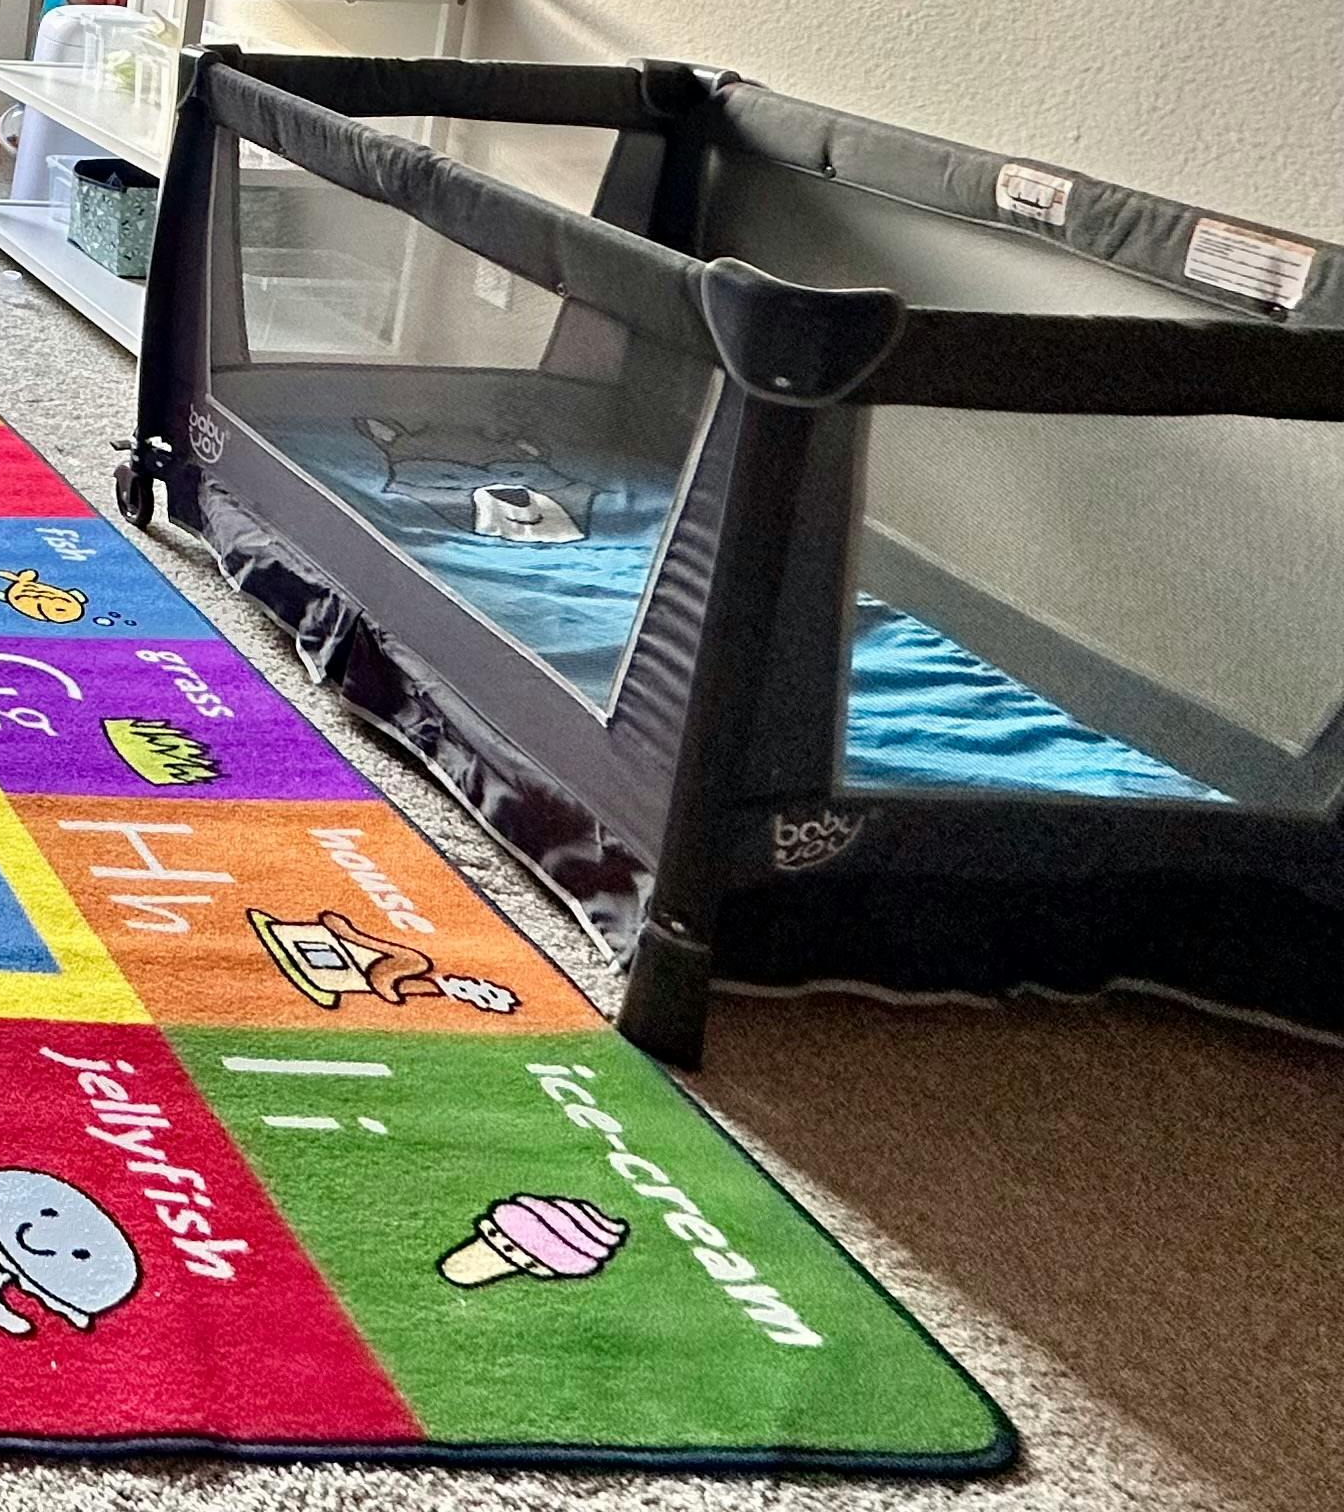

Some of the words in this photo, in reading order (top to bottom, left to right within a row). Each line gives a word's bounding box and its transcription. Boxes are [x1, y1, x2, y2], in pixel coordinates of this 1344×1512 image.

[188, 402, 226, 450] baby
[34, 526, 98, 562] fish
[133, 647, 236, 722] grass
[774, 808, 866, 849] baby
[55, 817, 237, 935] Hh
[307, 826, 438, 936] house
[38, 1044, 252, 1282] jellyfish
[525, 1062, 826, 1349] ice-cream
